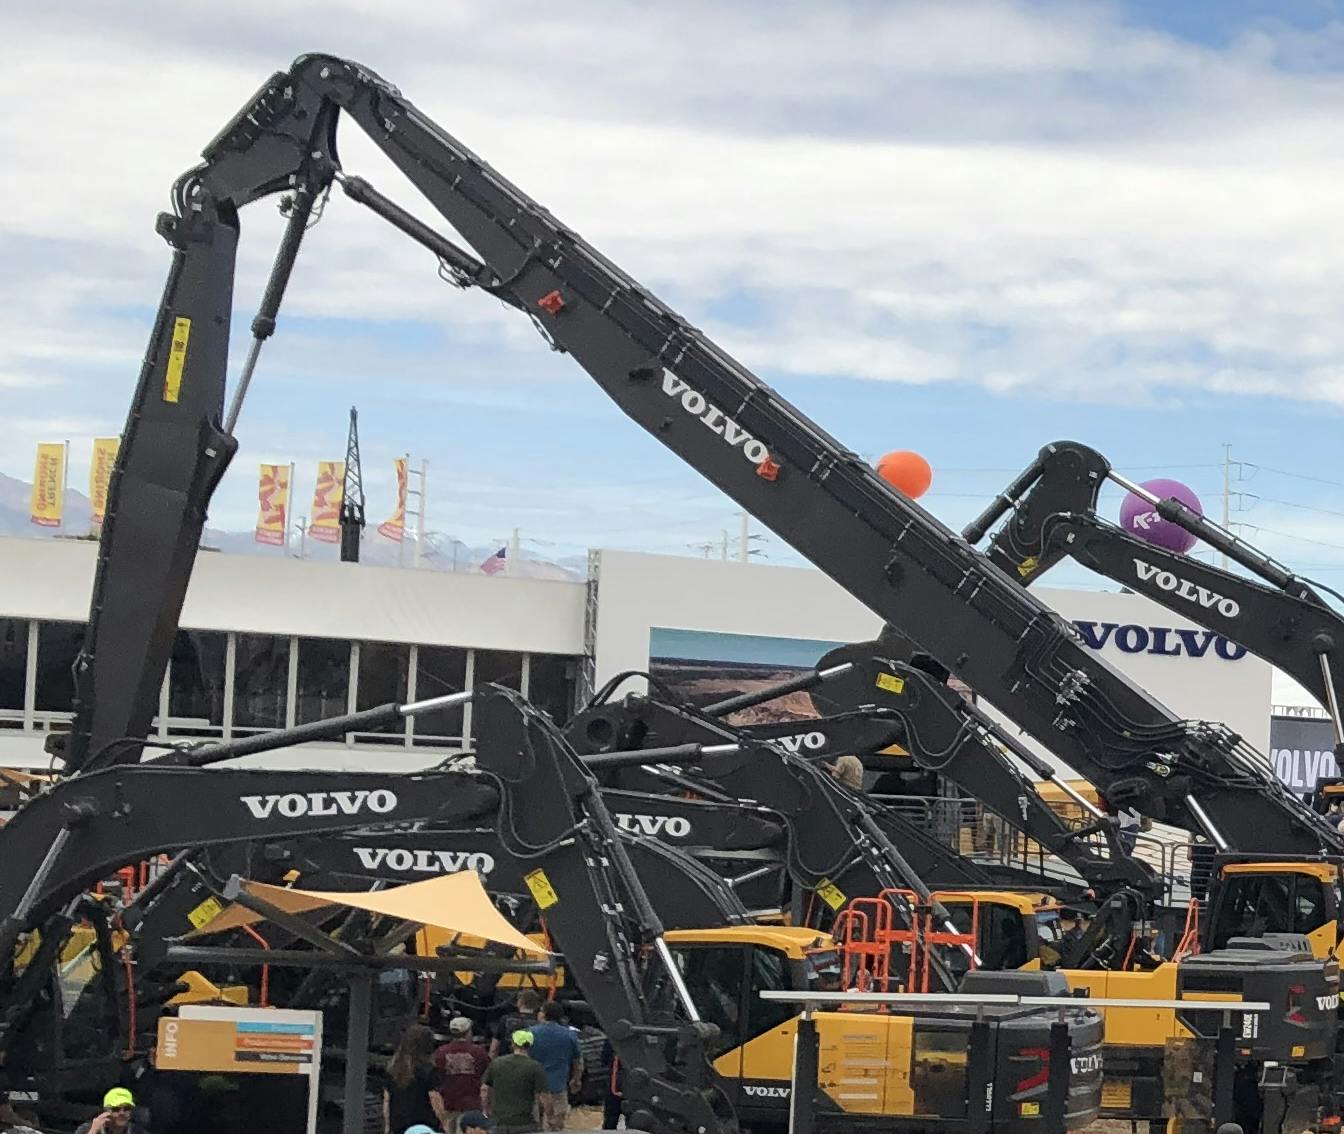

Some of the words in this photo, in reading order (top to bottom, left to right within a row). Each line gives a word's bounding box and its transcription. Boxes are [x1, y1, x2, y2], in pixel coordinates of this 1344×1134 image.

[662, 366, 769, 464] VOLVO
[1133, 558, 1240, 618] VOLVO
[1072, 620, 1249, 661] VOLVO
[240, 789, 397, 819] VOLVO
[615, 813, 691, 837] LVO
[353, 847, 495, 874] VOLVO
[164, 1022, 178, 1057] INFO
[743, 1086, 790, 1098] VOLV
